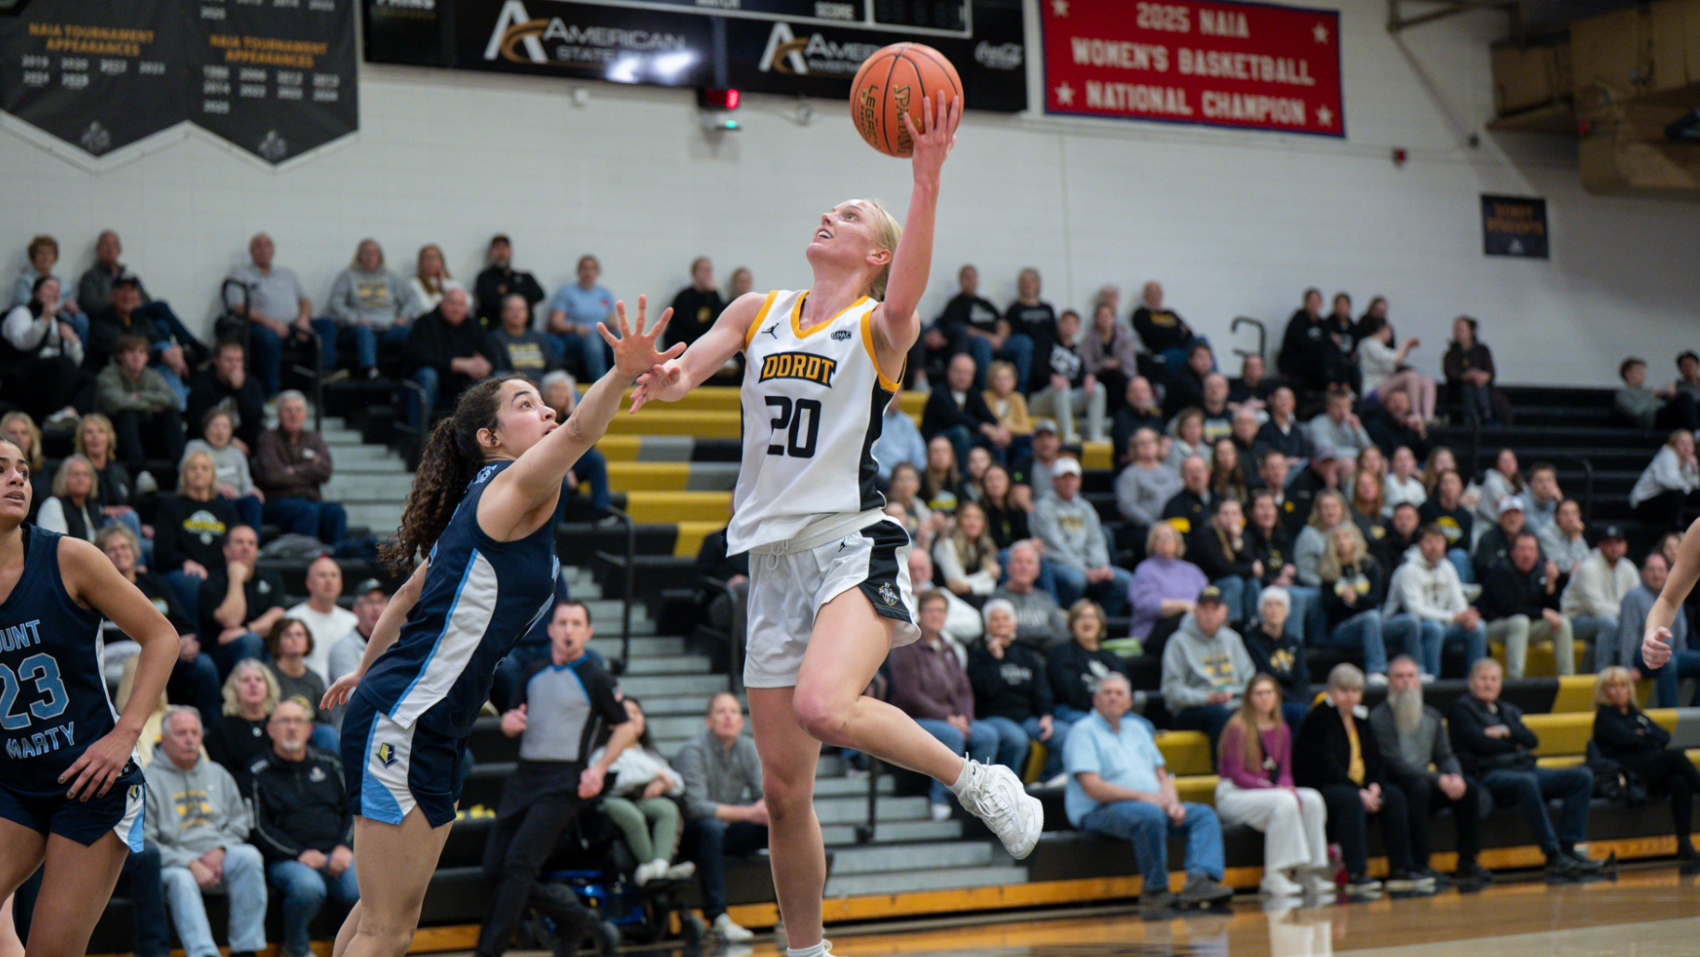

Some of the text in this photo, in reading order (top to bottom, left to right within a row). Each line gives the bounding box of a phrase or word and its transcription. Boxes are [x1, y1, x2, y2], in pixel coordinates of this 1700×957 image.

[815, 1, 855, 20] SCORE
[1136, 3, 1250, 39] 2025 NAIA
[29, 22, 154, 43] NAIA TOURNAMENT
[46, 37, 140, 57] APPEARANCES
[209, 34, 328, 56] NAIA TOURNAMENT
[543, 16, 686, 50] AMERICAN
[225, 50, 314, 69] APPEARANCES
[556, 45, 615, 62] STATE
[1071, 36, 1316, 86] WOMEN'S BASKETBALL
[865, 84, 882, 150] LEGACY
[1085, 80, 1307, 125] NATIONAL CHAMPION
[760, 353, 836, 386] DORDT
[764, 396, 822, 459] 20
[0, 619, 41, 653] UNT
[0, 652, 70, 730] 23
[6, 721, 75, 759] MARTY
